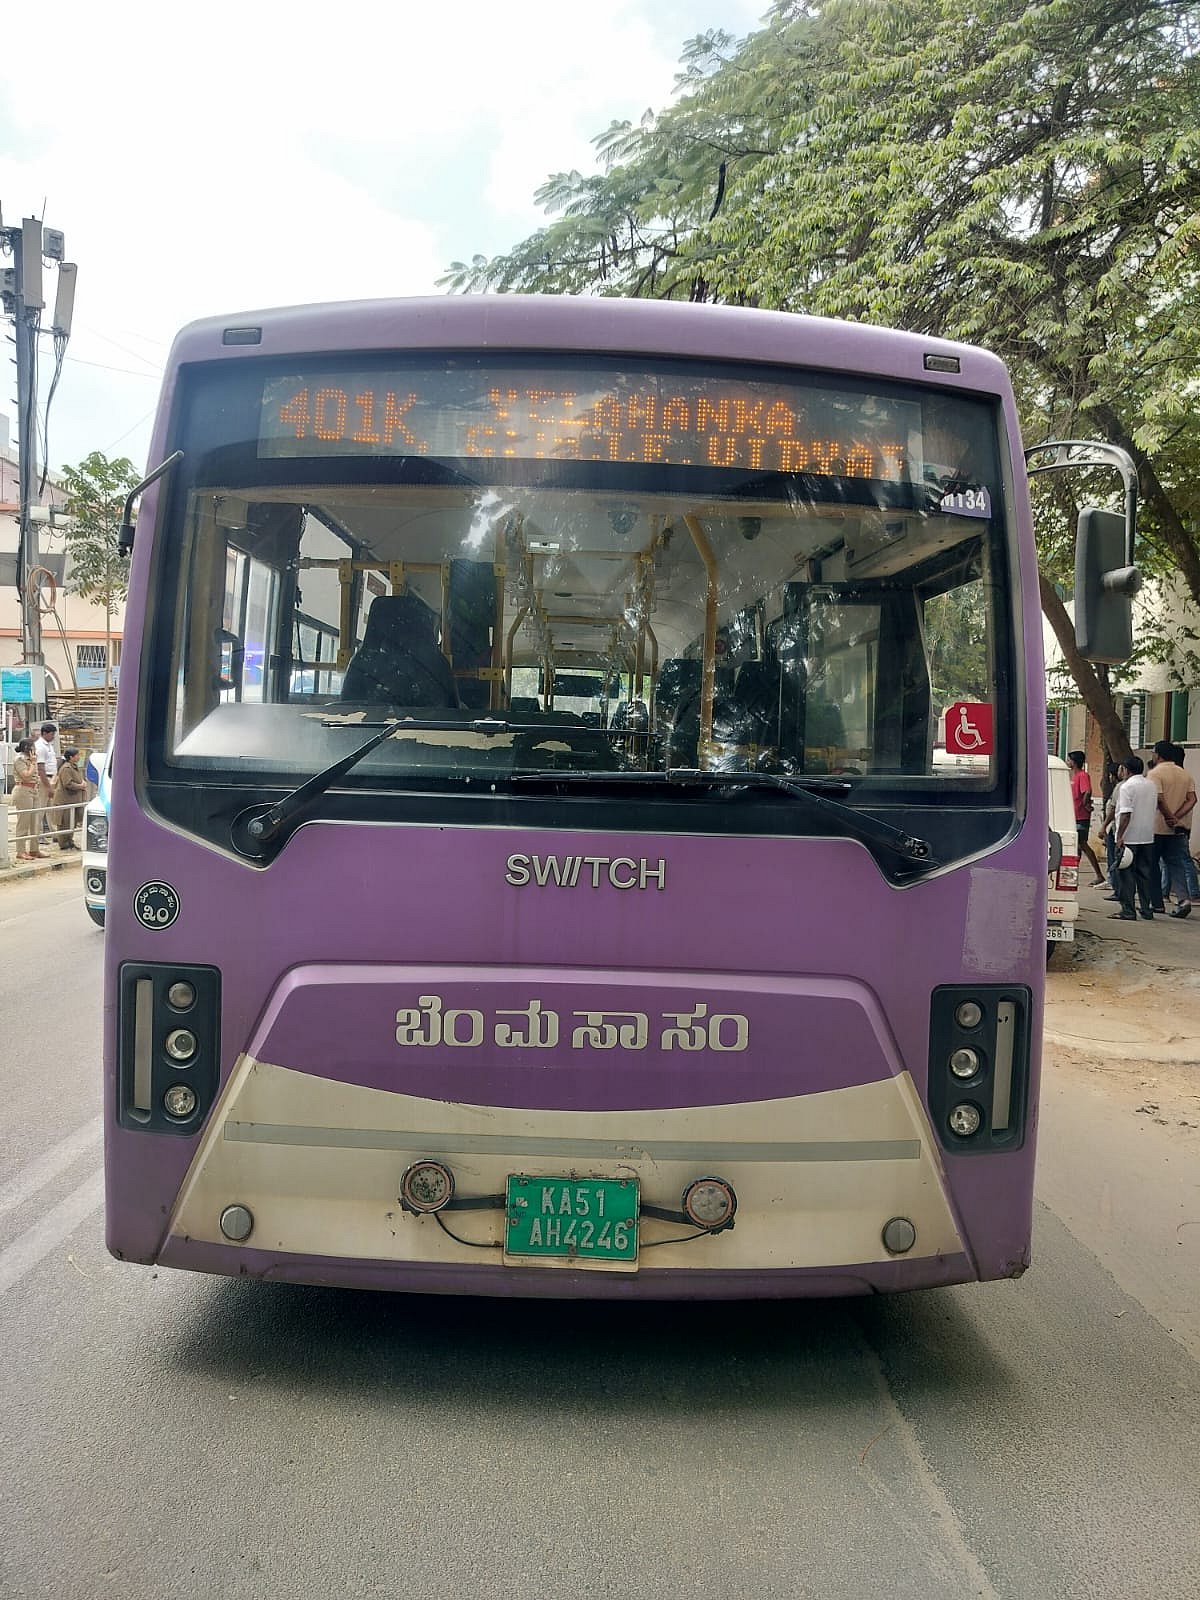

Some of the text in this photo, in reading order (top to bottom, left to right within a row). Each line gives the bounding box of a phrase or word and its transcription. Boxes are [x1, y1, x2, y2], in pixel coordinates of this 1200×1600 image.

[505, 854, 665, 889] SWITCH
[1047, 906, 1063, 914] ICE
[541, 1187, 605, 1217] KA51
[529, 1218, 628, 1250] AH4246
